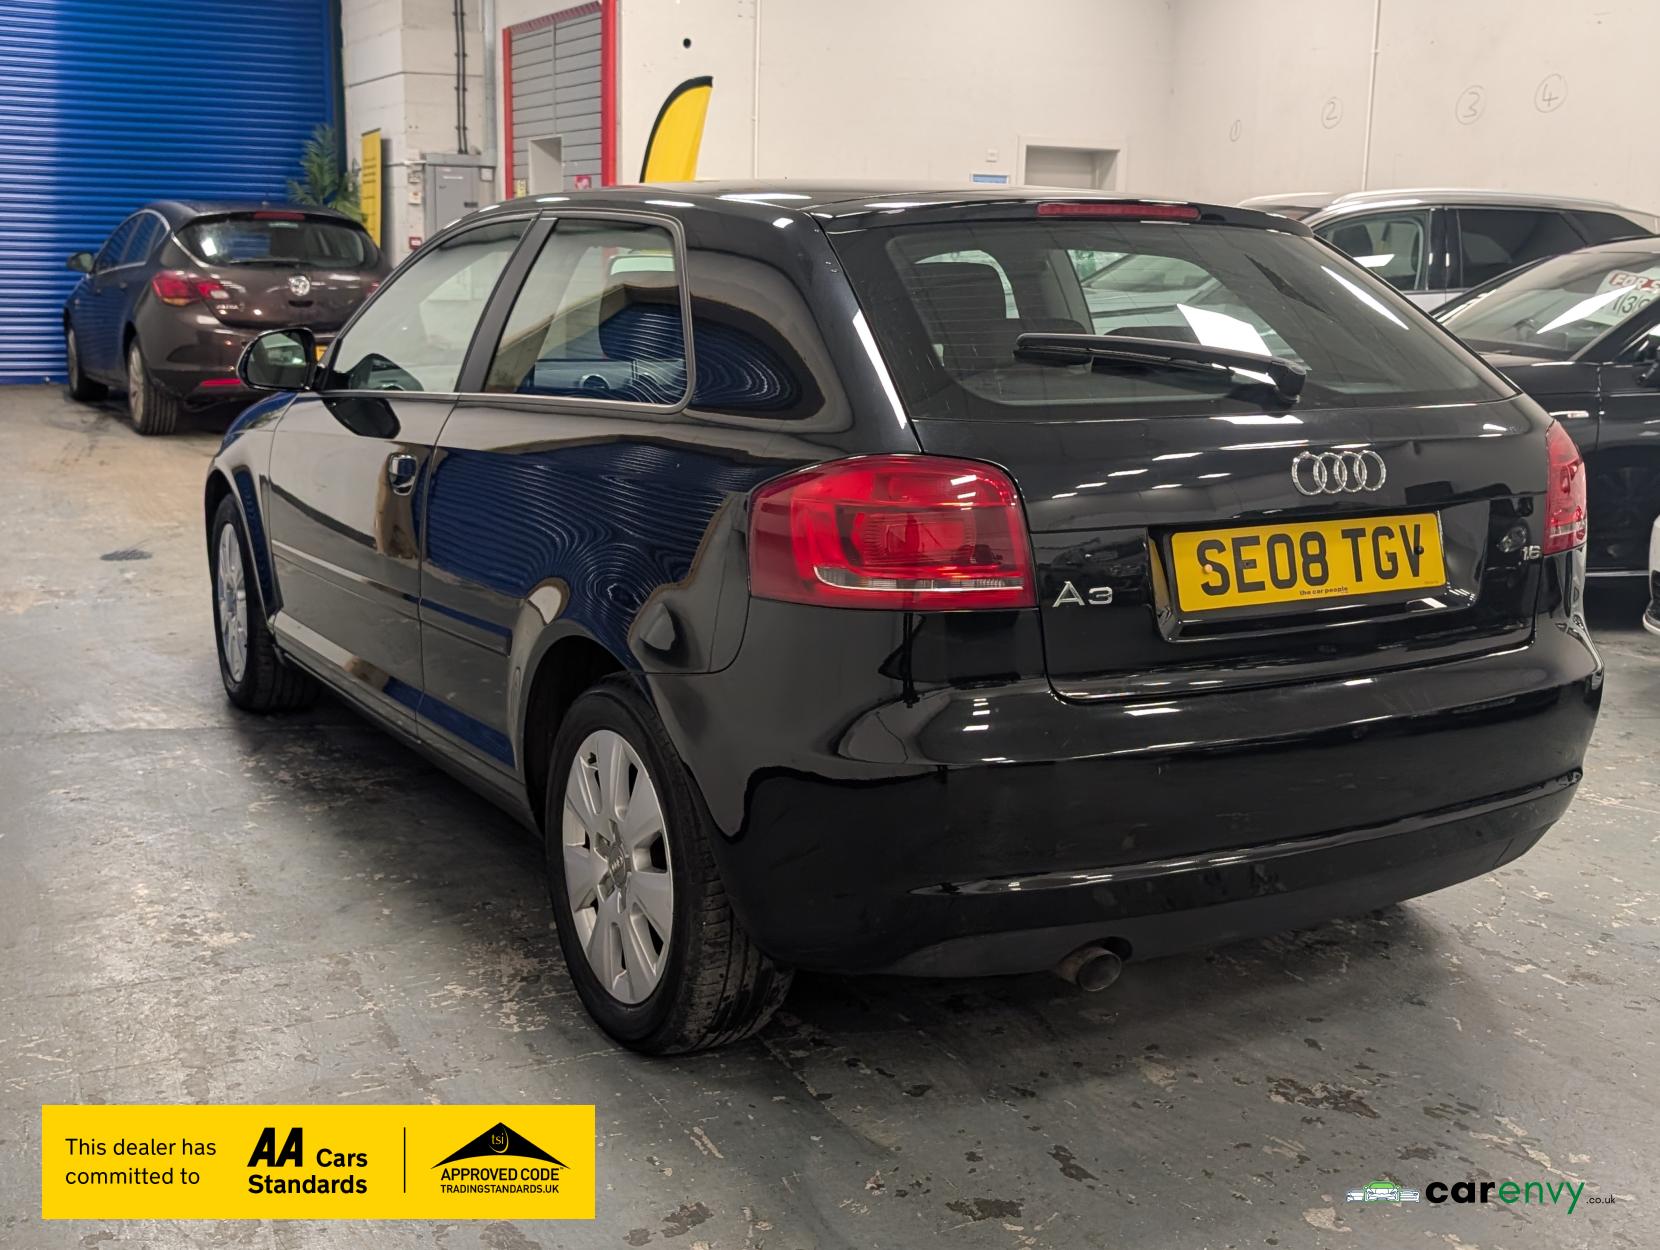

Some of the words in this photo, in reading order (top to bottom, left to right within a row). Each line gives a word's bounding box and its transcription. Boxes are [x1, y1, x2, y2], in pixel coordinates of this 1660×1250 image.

[1610, 272, 1648, 290] FOR
[1197, 531, 1330, 596] SE08
[1341, 524, 1422, 582] TGV
[1052, 580, 1114, 608] A3
[1299, 589, 1312, 597] the
[1325, 586, 1349, 595] people
